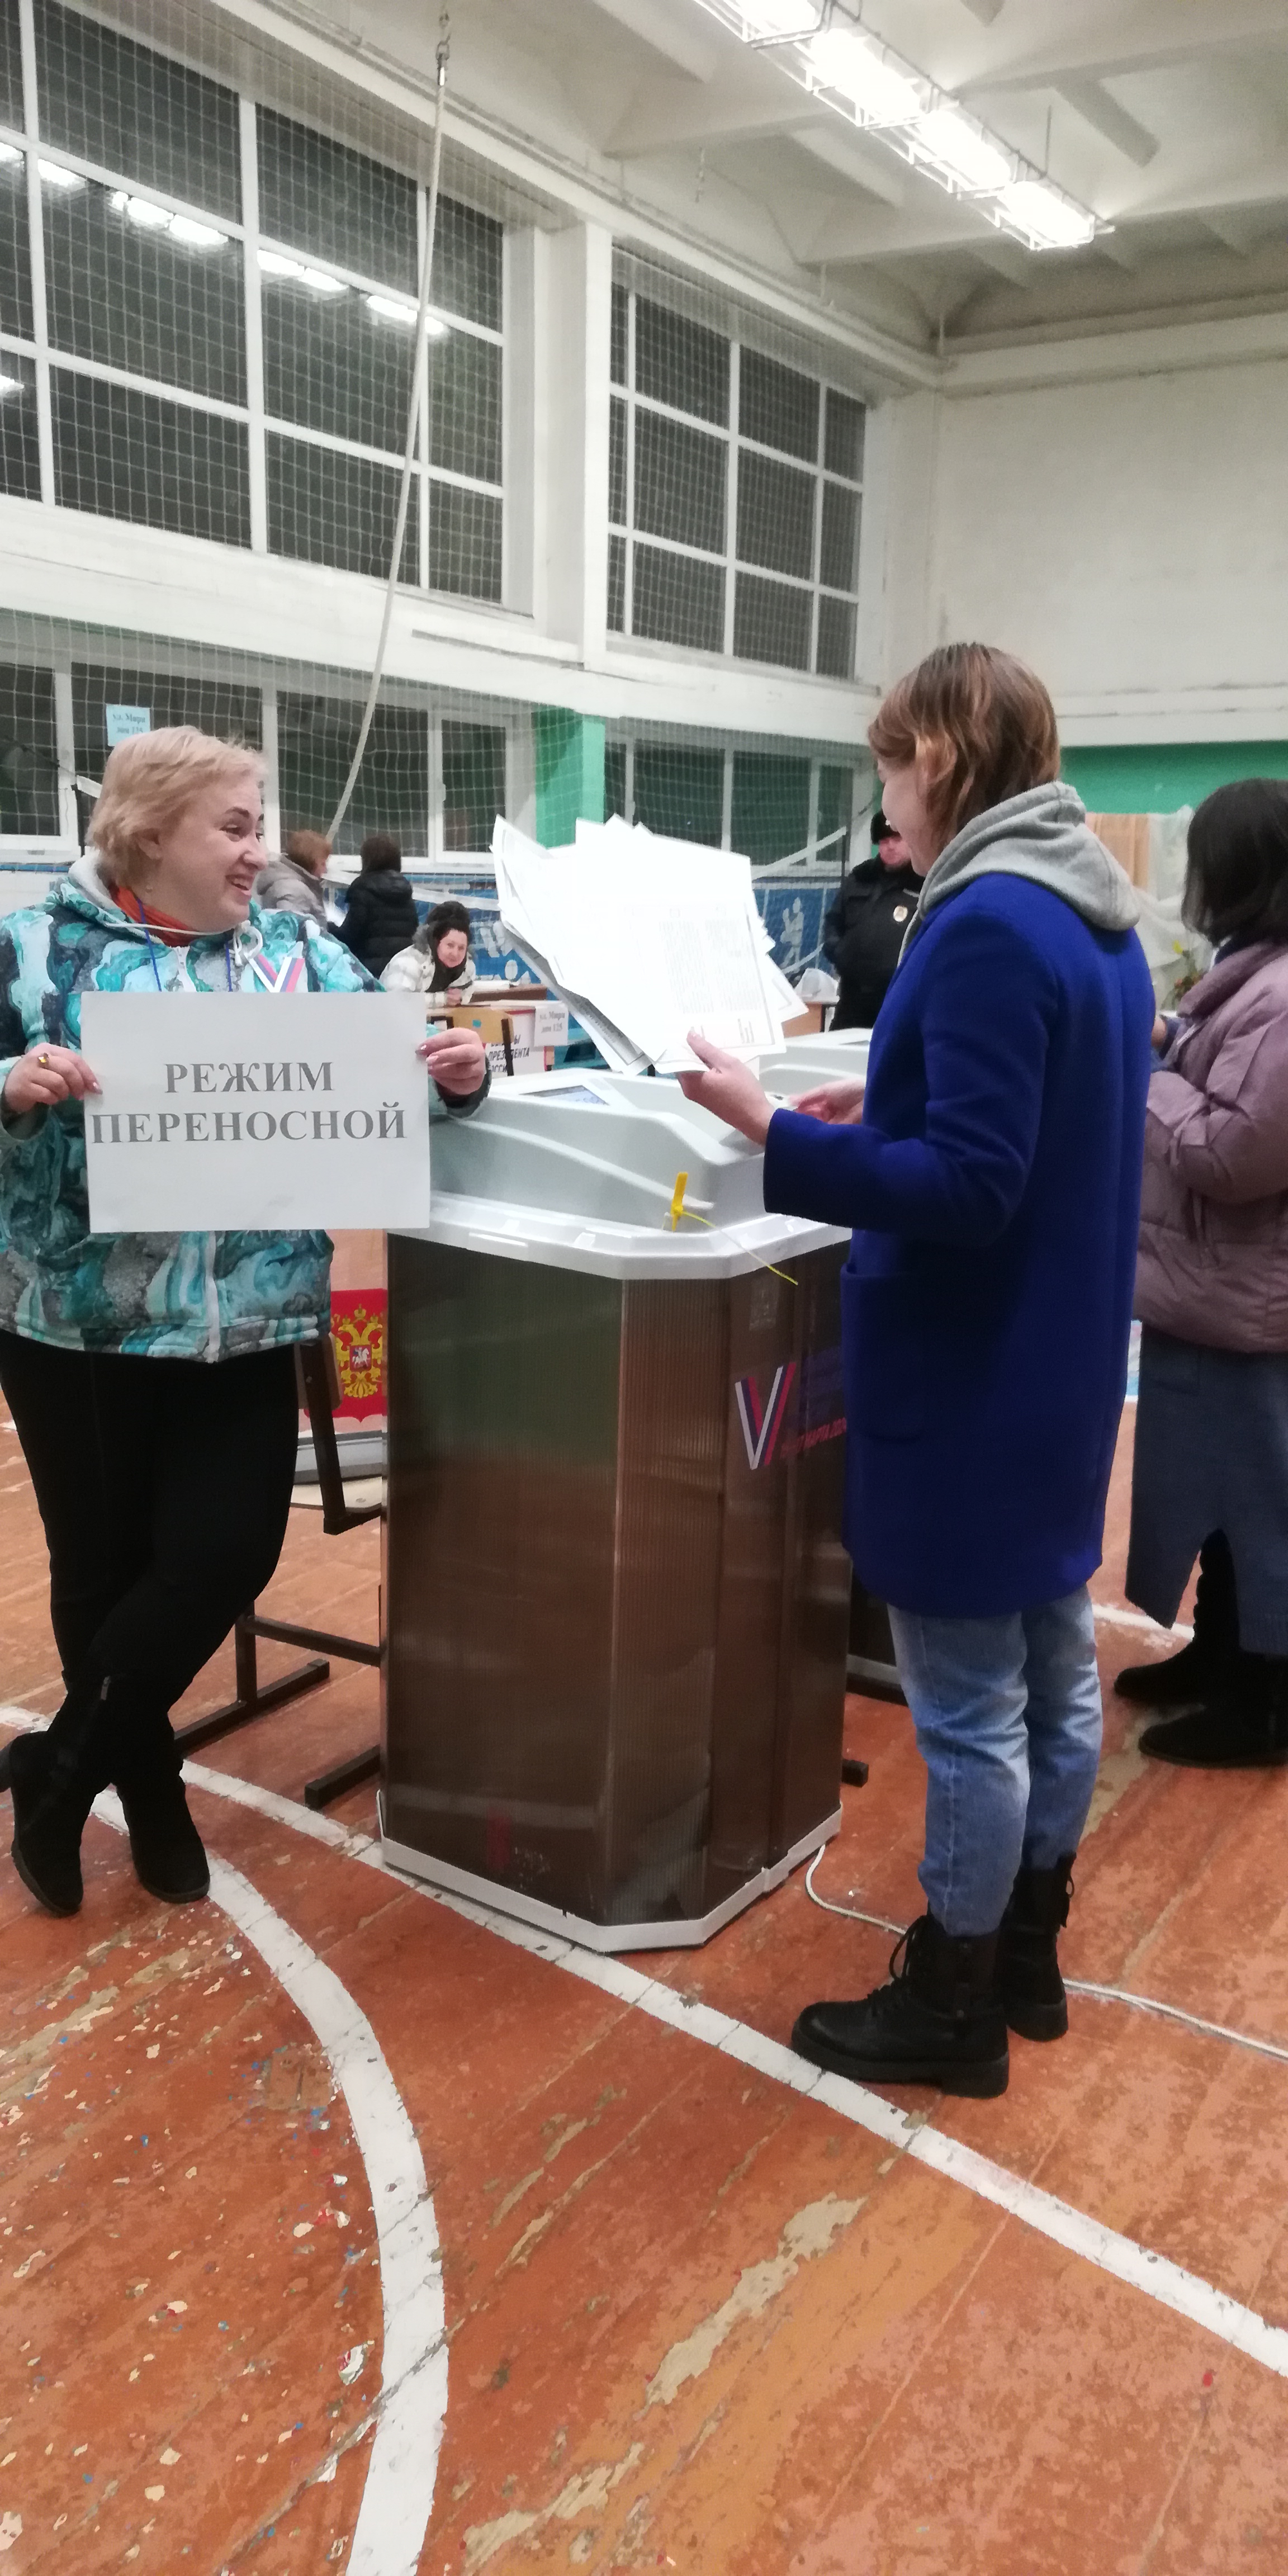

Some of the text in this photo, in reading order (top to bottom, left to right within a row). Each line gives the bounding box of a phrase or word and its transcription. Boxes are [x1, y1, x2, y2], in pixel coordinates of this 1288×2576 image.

[488, 1047, 530, 1061] ПРЕЗДЕНТА
[165, 1062, 334, 1093] РЕЖИМ
[92, 1102, 406, 1143] ПЕРЕНОСНОЙ
